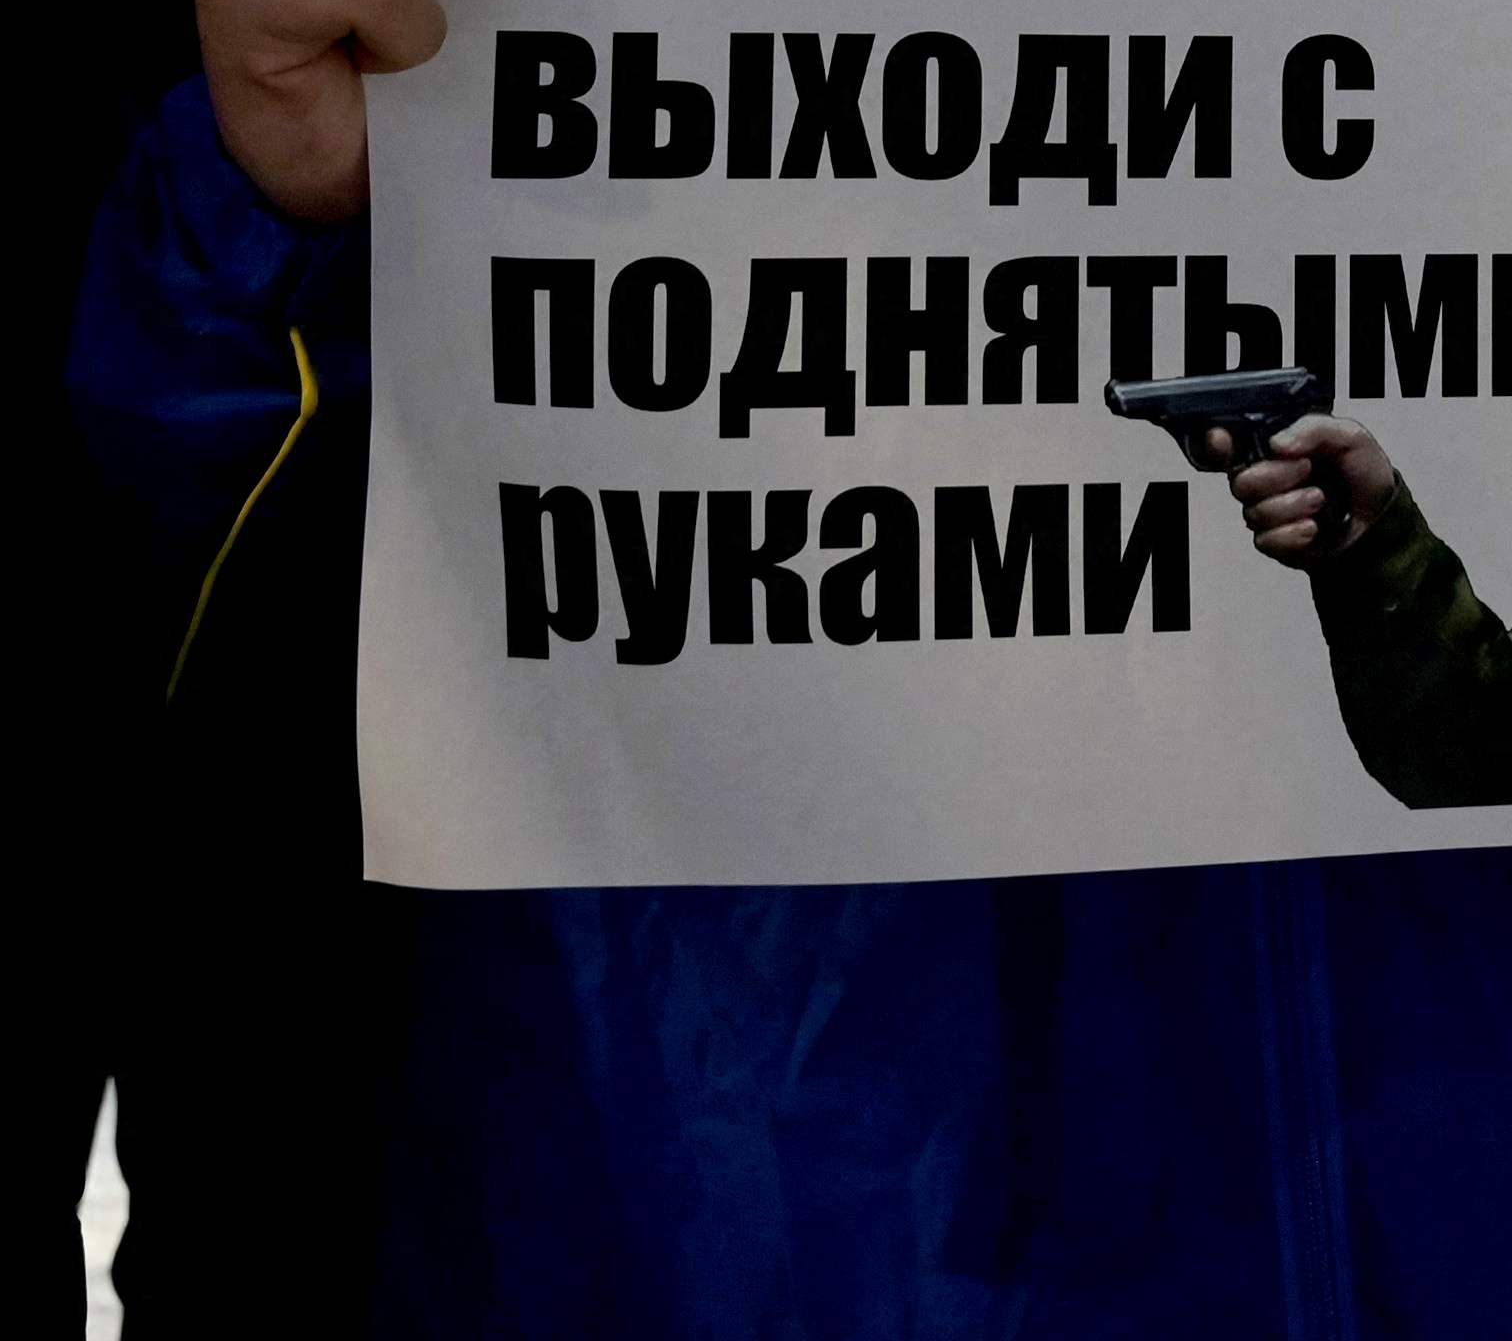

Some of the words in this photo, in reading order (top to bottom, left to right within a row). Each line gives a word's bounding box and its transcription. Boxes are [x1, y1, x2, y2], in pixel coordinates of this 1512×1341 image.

[489, 28, 1235, 208] выходи
[1280, 32, 1377, 182] с
[497, 479, 1193, 668] руками
